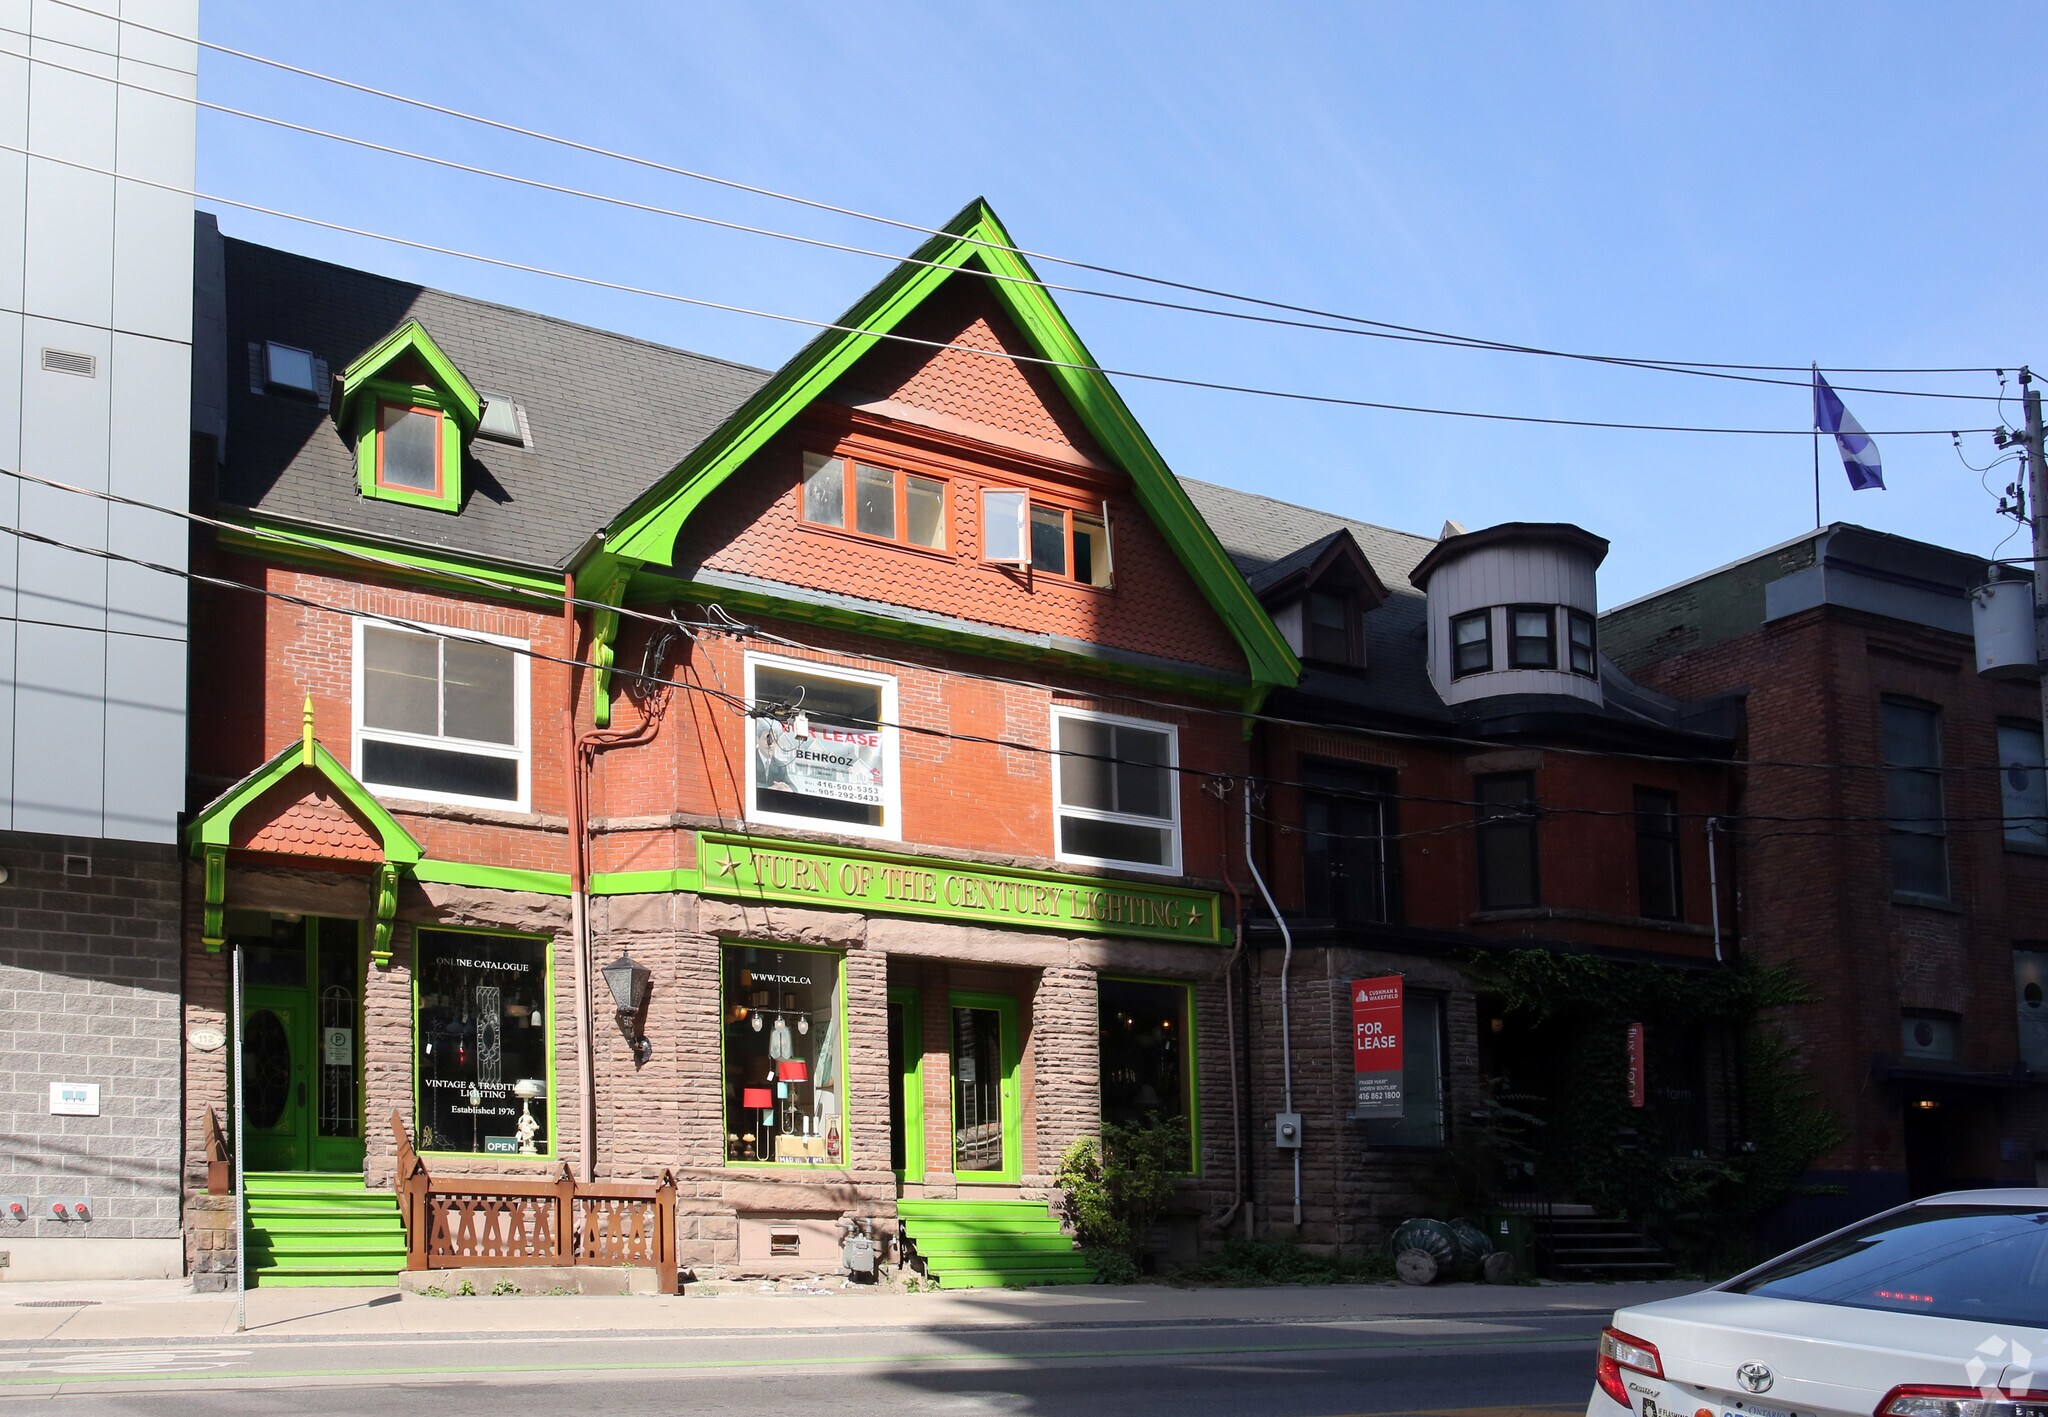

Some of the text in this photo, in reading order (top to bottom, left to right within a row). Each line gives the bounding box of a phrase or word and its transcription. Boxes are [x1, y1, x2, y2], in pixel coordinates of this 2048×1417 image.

[823, 729, 878, 747] LEASE
[796, 749, 853, 767] BEHROOZ
[817, 780, 879, 795] 416-500-5353
[818, 787, 880, 803] 905-292-5433
[750, 852, 1181, 929] TURN OF THE CENTURY LIGHTING
[474, 959, 530, 972] CATALOGUE
[750, 973, 812, 985] WWW.TOCL.CA
[1369, 993, 1399, 1001] WAKEFIELD
[1357, 1022, 1382, 1036] FOR
[199, 1035, 214, 1043] 112
[1358, 1035, 1396, 1050] LEASE
[425, 1079, 467, 1089] VINTAGE
[468, 1081, 476, 1090] &
[451, 1105, 516, 1116] Established 1976
[487, 1142, 516, 1152] OPEN
